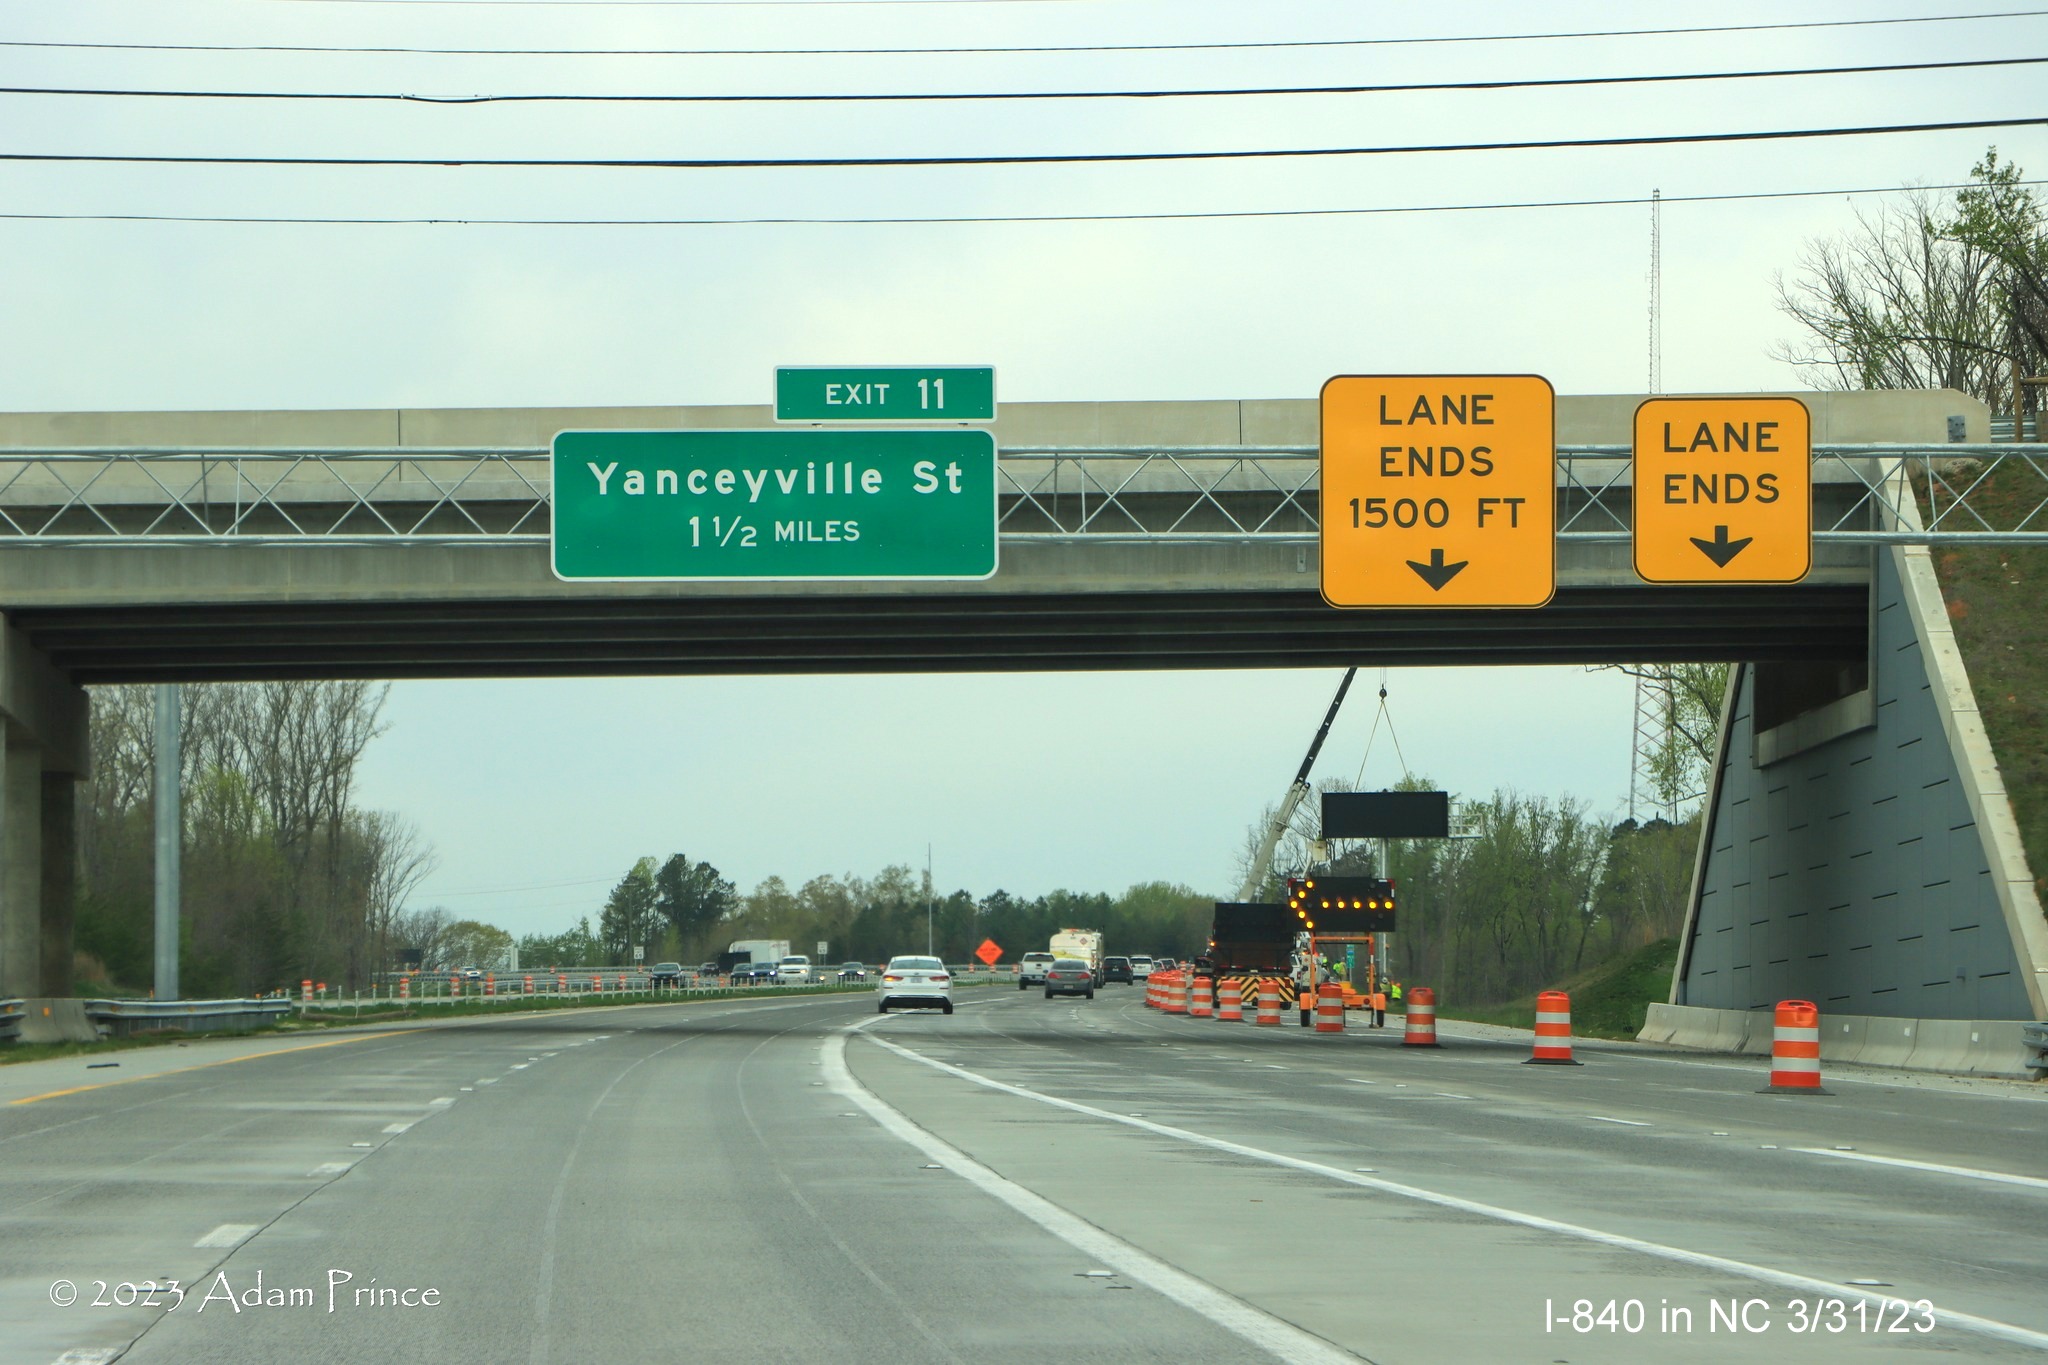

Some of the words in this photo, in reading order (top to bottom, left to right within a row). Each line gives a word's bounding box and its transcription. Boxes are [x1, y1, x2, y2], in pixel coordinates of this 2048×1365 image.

[825, 383, 890, 405] EXIT
[917, 378, 944, 409] 11
[1379, 394, 1495, 426] LANE
[1663, 421, 1780, 453] LANE
[1380, 445, 1494, 477] ENDS
[587, 461, 882, 503] Yanceyville
[912, 460, 962, 494] St
[1664, 472, 1780, 505] ENDS
[1349, 497, 1450, 529] 1500
[1477, 497, 1526, 529] FT
[774, 520, 860, 542] MILES
